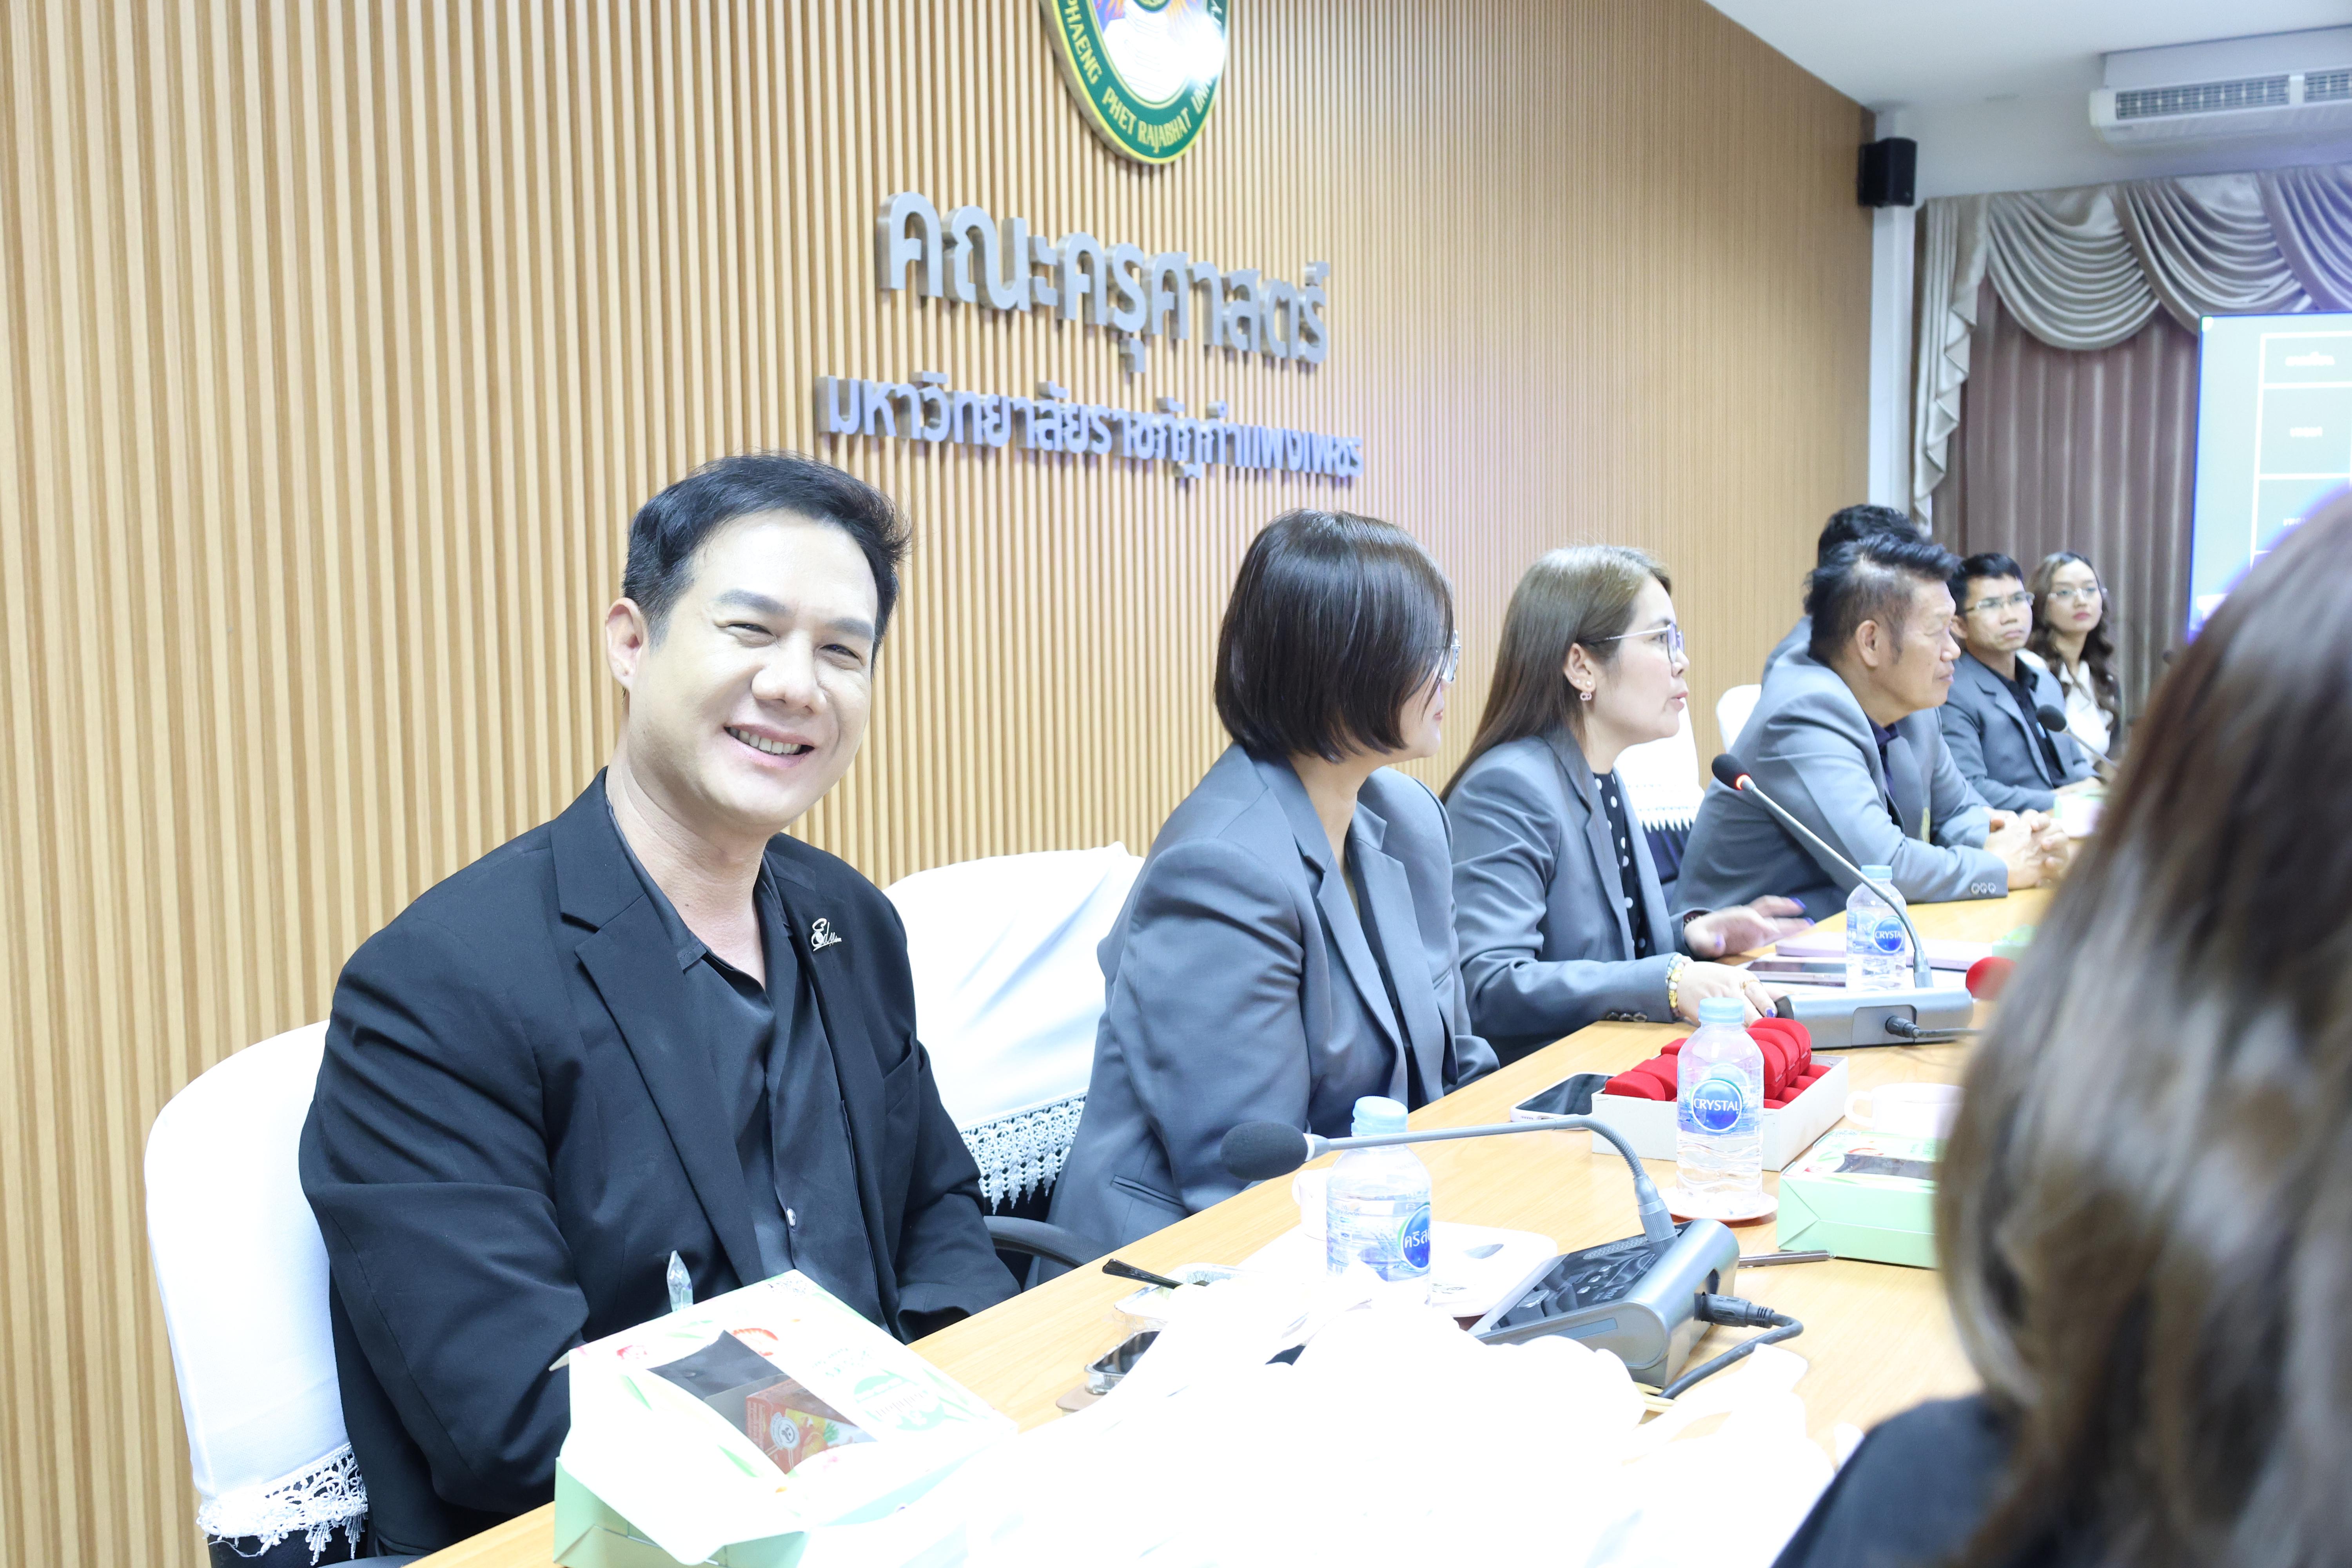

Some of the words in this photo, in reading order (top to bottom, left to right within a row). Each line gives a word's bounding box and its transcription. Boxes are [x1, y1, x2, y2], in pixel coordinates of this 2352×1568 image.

[1102, 85, 1137, 135] PHET
[1138, 107, 1192, 154] RAJABHAT
[877, 191, 1330, 372] คณะครุศาสตร์
[815, 370, 1363, 479] มหาวิทยาลัยราชภัฏกำแพงเพชร
[1693, 1098, 1739, 1111] CRYSTAL
